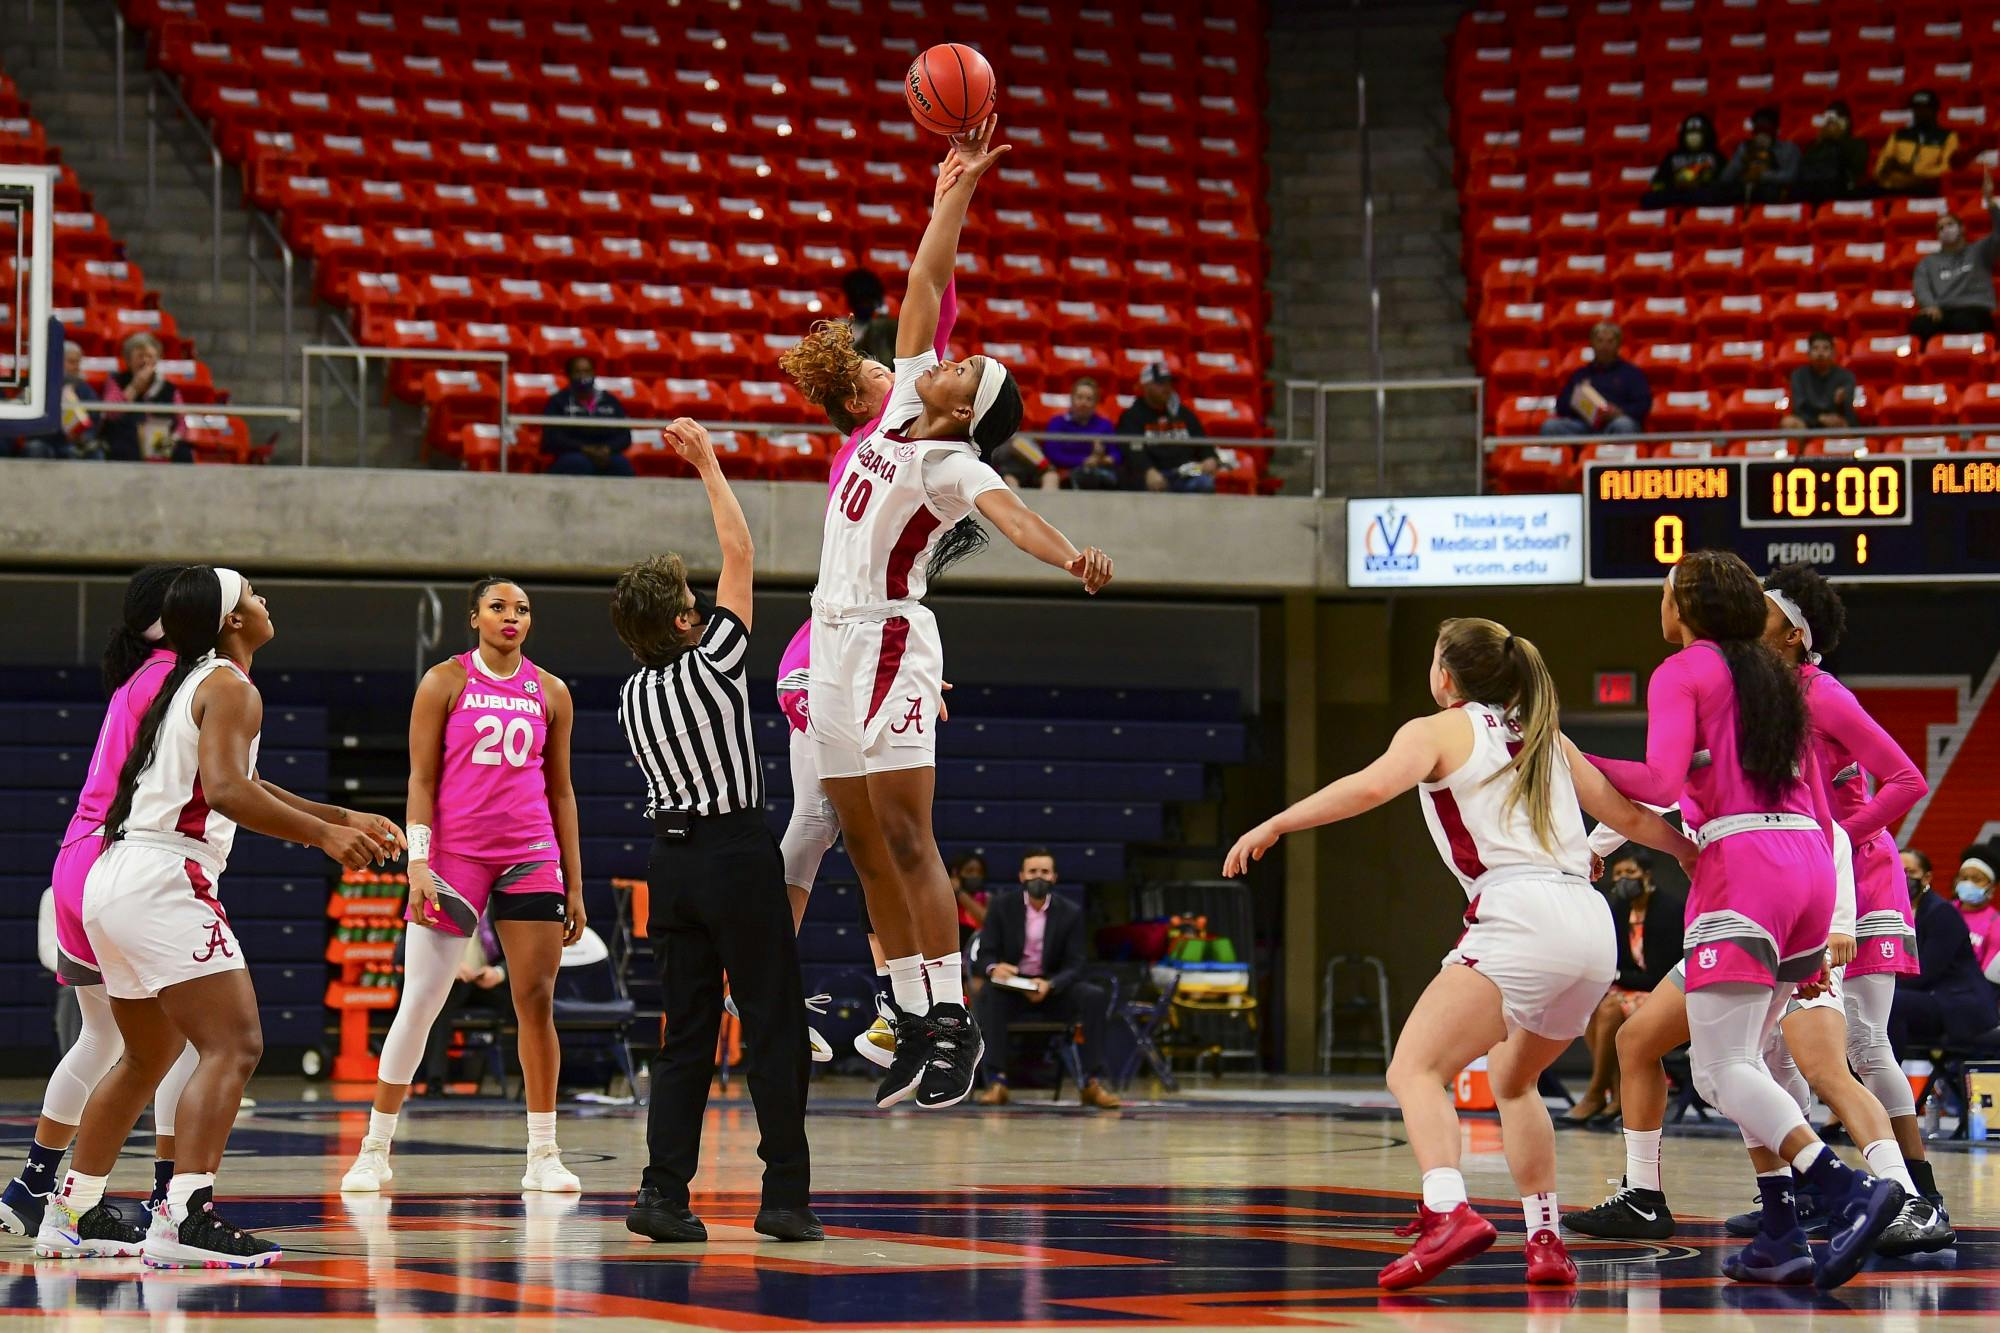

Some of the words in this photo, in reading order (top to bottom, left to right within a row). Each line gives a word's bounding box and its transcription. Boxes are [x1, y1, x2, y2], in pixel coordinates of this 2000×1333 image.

[1600, 468, 1728, 500] AUBURN
[1772, 466, 1899, 517] 10:00
[1453, 512, 1526, 530] Thinking
[1532, 512, 1548, 528] of
[1431, 536, 1498, 551] Medical
[1503, 533, 1571, 551] School?
[1654, 515, 1684, 564] 0
[1856, 533, 1867, 565] 1
[1454, 559, 1548, 575] vcom.edu
[1767, 542, 1836, 565] PERIOD
[462, 693, 541, 716] AUBURN
[471, 714, 534, 768] 20
